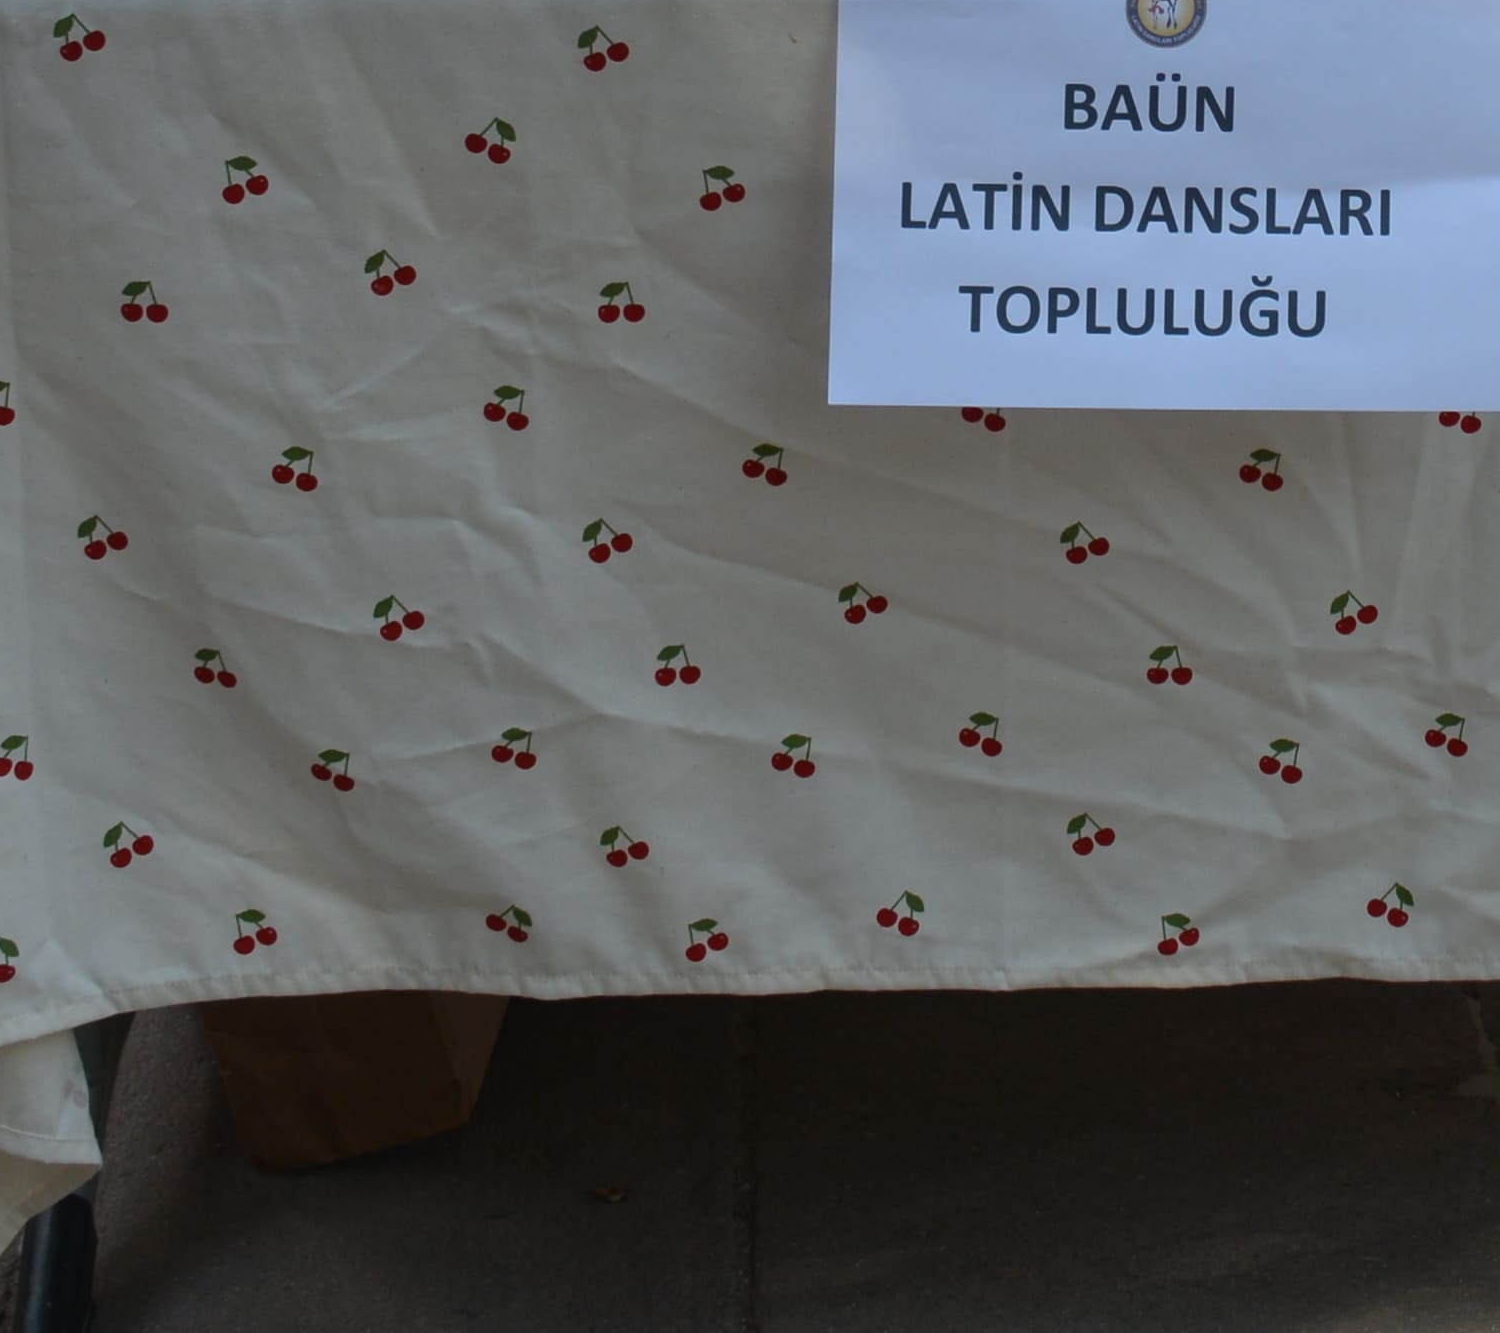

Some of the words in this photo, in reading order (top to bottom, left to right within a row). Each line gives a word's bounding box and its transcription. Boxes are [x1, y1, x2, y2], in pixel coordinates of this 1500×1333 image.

[1064, 72, 1235, 133] BAÜN
[900, 171, 1071, 232] LATİN
[1094, 185, 1391, 236] DANSLARI
[958, 275, 1326, 338] TOPLULUĞU
